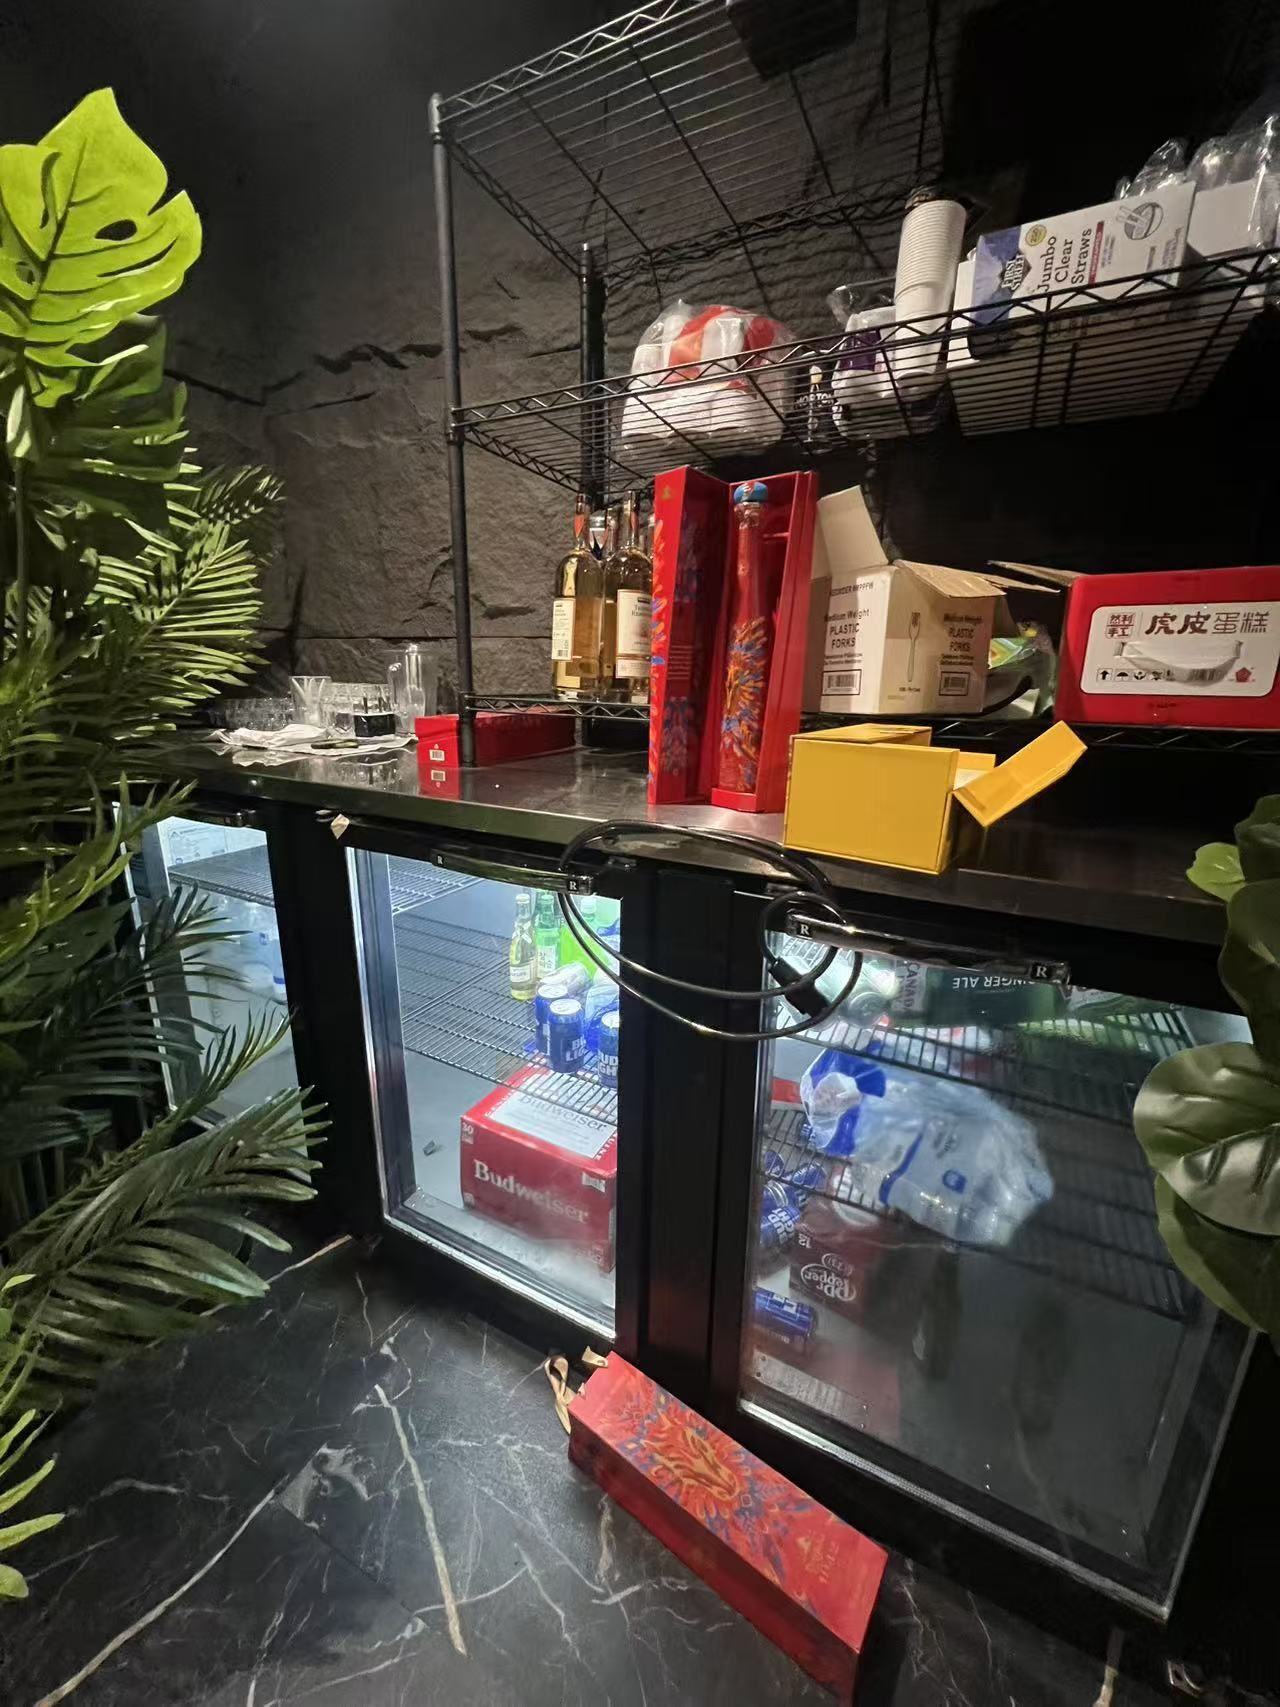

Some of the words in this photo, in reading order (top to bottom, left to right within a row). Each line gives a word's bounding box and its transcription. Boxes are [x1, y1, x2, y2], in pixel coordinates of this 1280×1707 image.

[1037, 236, 1057, 292] Jumbo
[1055, 239, 1073, 283] Clear
[1071, 228, 1093, 285] Straws
[1001, 258, 1017, 289] FIRST
[829, 623, 860, 636] PLASTIC
[1145, 611, 1270, 635] 虎皮蛋糕
[1107, 627, 1130, 638] 手工
[831, 637, 856, 649] FORKS
[569, 881, 577, 891] R
[800, 924, 810, 936] R
[1036, 966, 1048, 978] R
[952, 977, 979, 989] ALE
[462, 1122, 474, 1135] 30
[473, 1158, 589, 1225] Budweiser
[804, 1270, 853, 1301] Pepper
[816, 1281, 835, 1298] Dr
